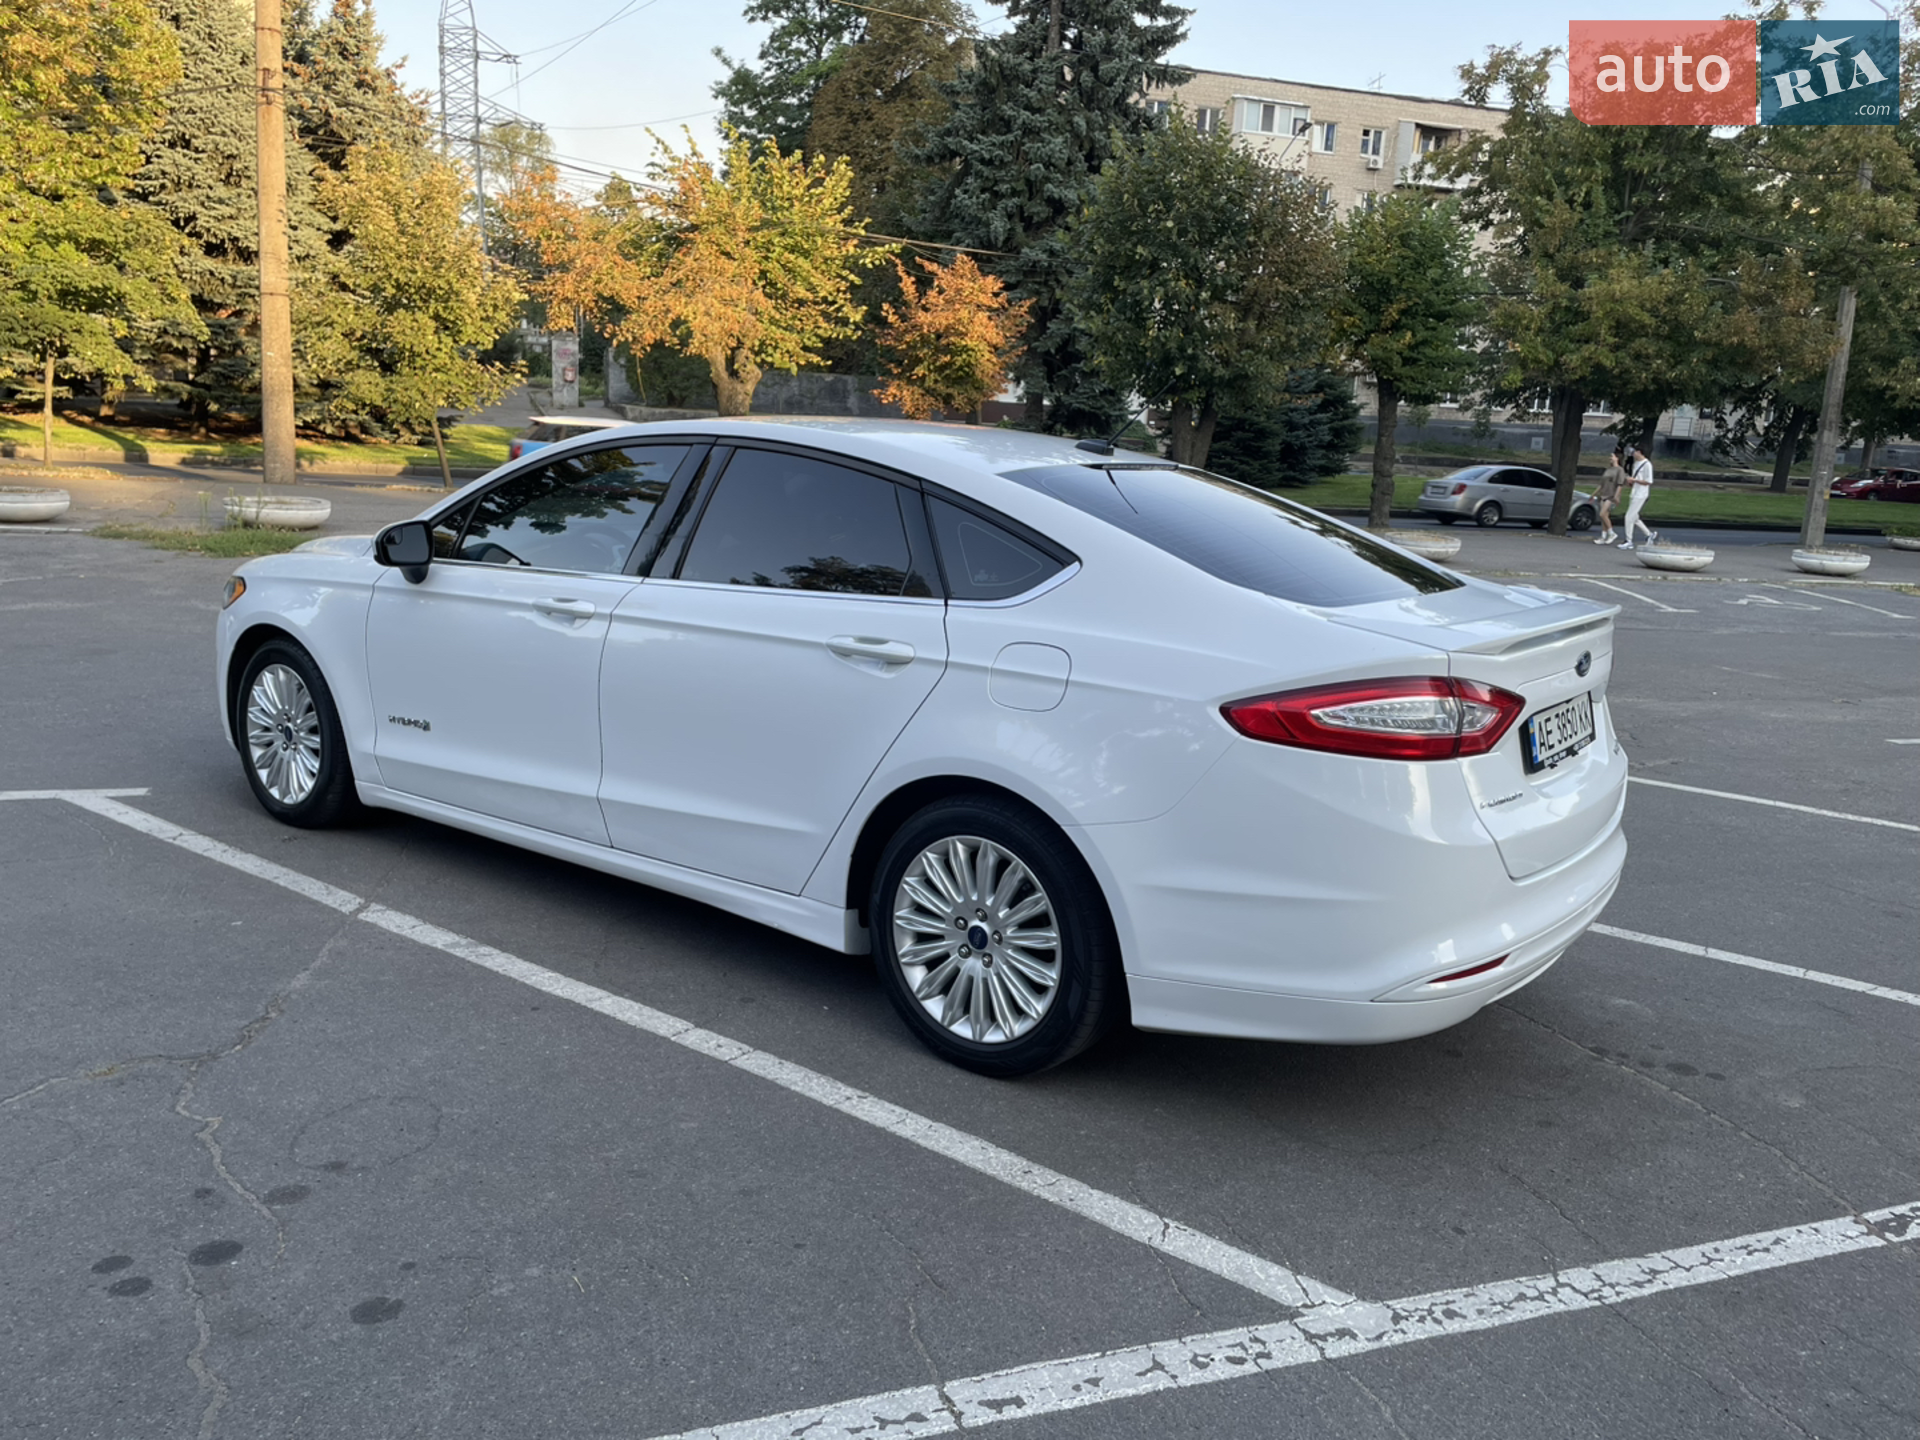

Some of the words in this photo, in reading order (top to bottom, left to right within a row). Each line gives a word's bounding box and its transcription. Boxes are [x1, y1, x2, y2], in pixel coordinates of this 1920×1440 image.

[1538, 717, 1555, 755] AE
[1554, 706, 1579, 745] 3850
[1577, 698, 1592, 734] KK
